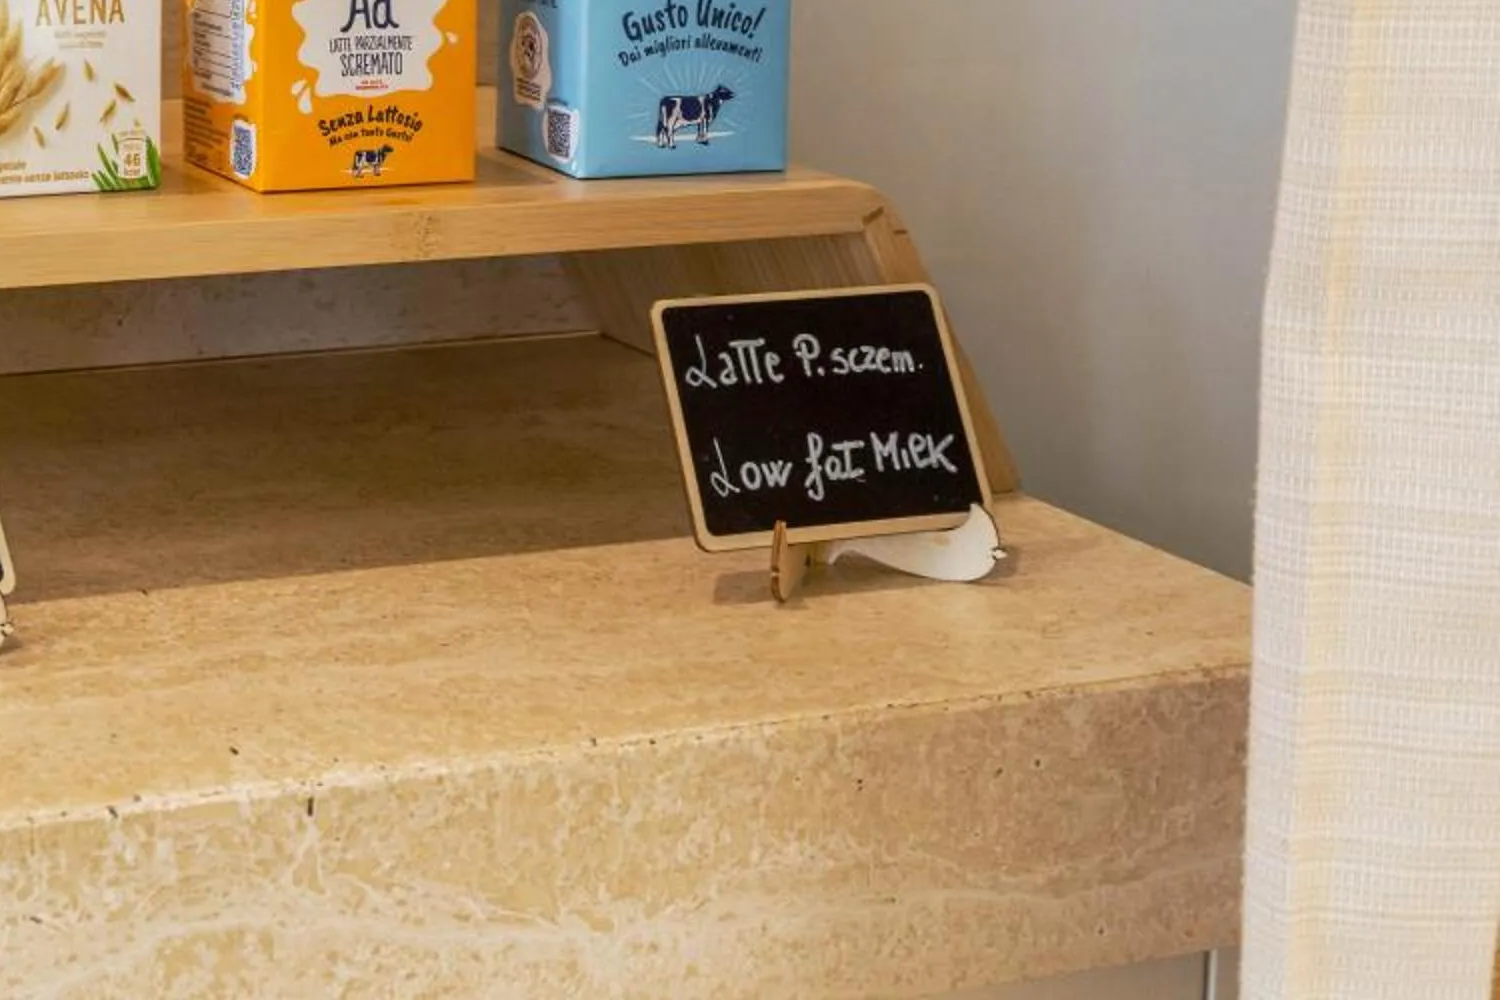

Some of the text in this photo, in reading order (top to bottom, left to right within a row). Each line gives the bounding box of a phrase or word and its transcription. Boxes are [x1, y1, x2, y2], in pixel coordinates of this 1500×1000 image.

[328, 34, 414, 53] LATTE PARZIALMENTE
[618, 31, 764, 67] Dai migliori allevamenti
[340, 51, 403, 77] SCREMATO
[317, 103, 424, 137] Senza Lattosio
[685, 333, 786, 389] Latte
[709, 436, 794, 498] Low
[804, 431, 866, 501] fat
